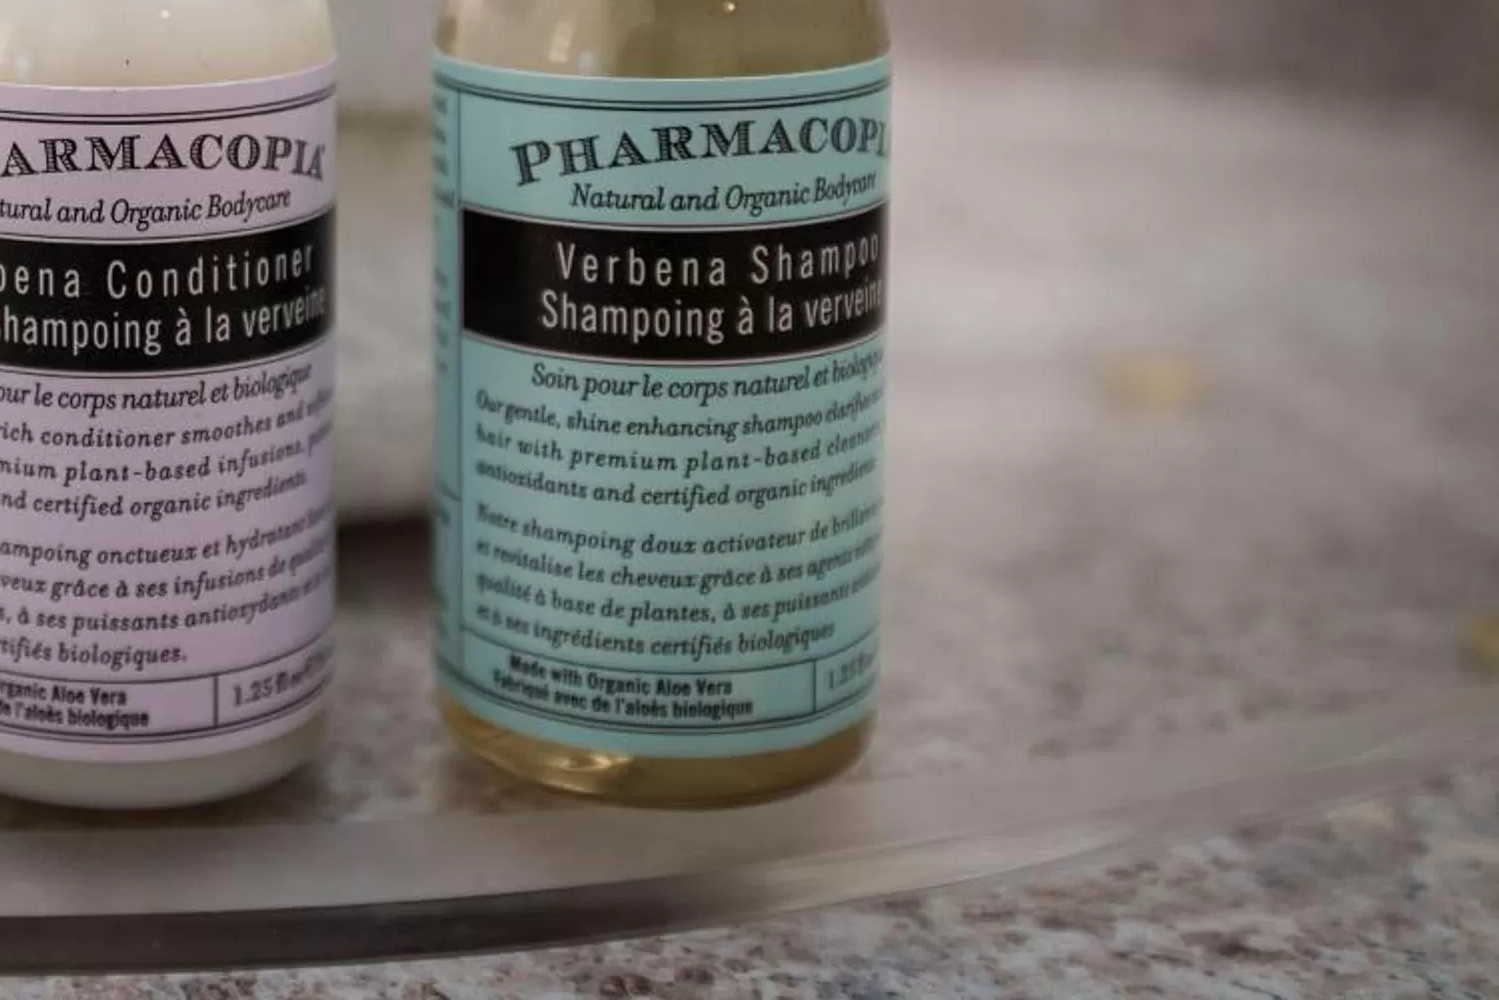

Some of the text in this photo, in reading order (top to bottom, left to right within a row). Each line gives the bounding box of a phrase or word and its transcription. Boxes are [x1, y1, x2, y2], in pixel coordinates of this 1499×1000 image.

[57, 198, 104, 225] and
[110, 199, 202, 232] Organic
[206, 188, 292, 223] Bodycare
[569, 182, 664, 212] Natural
[670, 184, 721, 212] and
[725, 182, 810, 217] Organic
[106, 243, 314, 300] Conditioner
[556, 231, 880, 287] Verbena Shampoo
[174, 306, 192, 346] à
[205, 304, 231, 344] la
[542, 288, 724, 346] Shampoing
[738, 294, 755, 336] à
[768, 296, 793, 334] la
[33, 381, 54, 408] le
[57, 392, 117, 419] corps
[121, 380, 206, 411] naturel
[210, 382, 229, 405] et
[531, 361, 579, 392] Soin
[581, 374, 640, 402] pour
[642, 373, 663, 399] le
[668, 380, 728, 407] corps
[733, 364, 811, 397] naturel
[813, 363, 830, 388] et
[40, 427, 176, 450] conditioner
[180, 414, 272, 447] smoothes
[276, 399, 305, 429] and
[476, 388, 504, 414] Our
[566, 409, 622, 435] shine
[626, 415, 740, 444] enhancing
[742, 408, 823, 437] shampoo
[475, 421, 822, 479] hair with premium plant-based
[63, 455, 212, 489] plant-based
[475, 460, 807, 513] antioxidants and certified organic
[33, 493, 124, 521] certified
[129, 492, 212, 523] organic
[97, 546, 198, 566] onctueux
[202, 539, 221, 559] et
[521, 515, 636, 560] shampoing
[641, 531, 697, 555] doux
[702, 528, 807, 555] activateur
[810, 519, 829, 543] de
[50, 578, 110, 603] grâce
[115, 579, 129, 598] à
[135, 582, 168, 598] ses
[173, 566, 265, 600] infusions
[493, 546, 574, 579] revitalise
[577, 559, 606, 584] les
[610, 565, 697, 589] cheveux
[699, 568, 757, 596] grâce
[760, 564, 773, 585] à
[777, 564, 804, 582] ses
[17, 605, 31, 625] à
[36, 612, 68, 630] ses
[72, 613, 180, 638] puissants
[551, 587, 596, 616] base
[600, 598, 626, 620] de
[628, 600, 717, 628] plantes,
[723, 602, 736, 622] à
[741, 603, 772, 620] ses
[57, 641, 188, 672] biologiques.
[533, 624, 646, 650] ingrédients
[650, 634, 734, 663] certifiés
[52, 684, 86, 705] Aloe
[89, 685, 128, 706] Vera
[233, 676, 273, 707] 1.25
[509, 653, 733, 698] Made with Organic Aloe Vera
[67, 707, 150, 731] biologique
[592, 697, 611, 714] de
[672, 701, 756, 721] biologique
